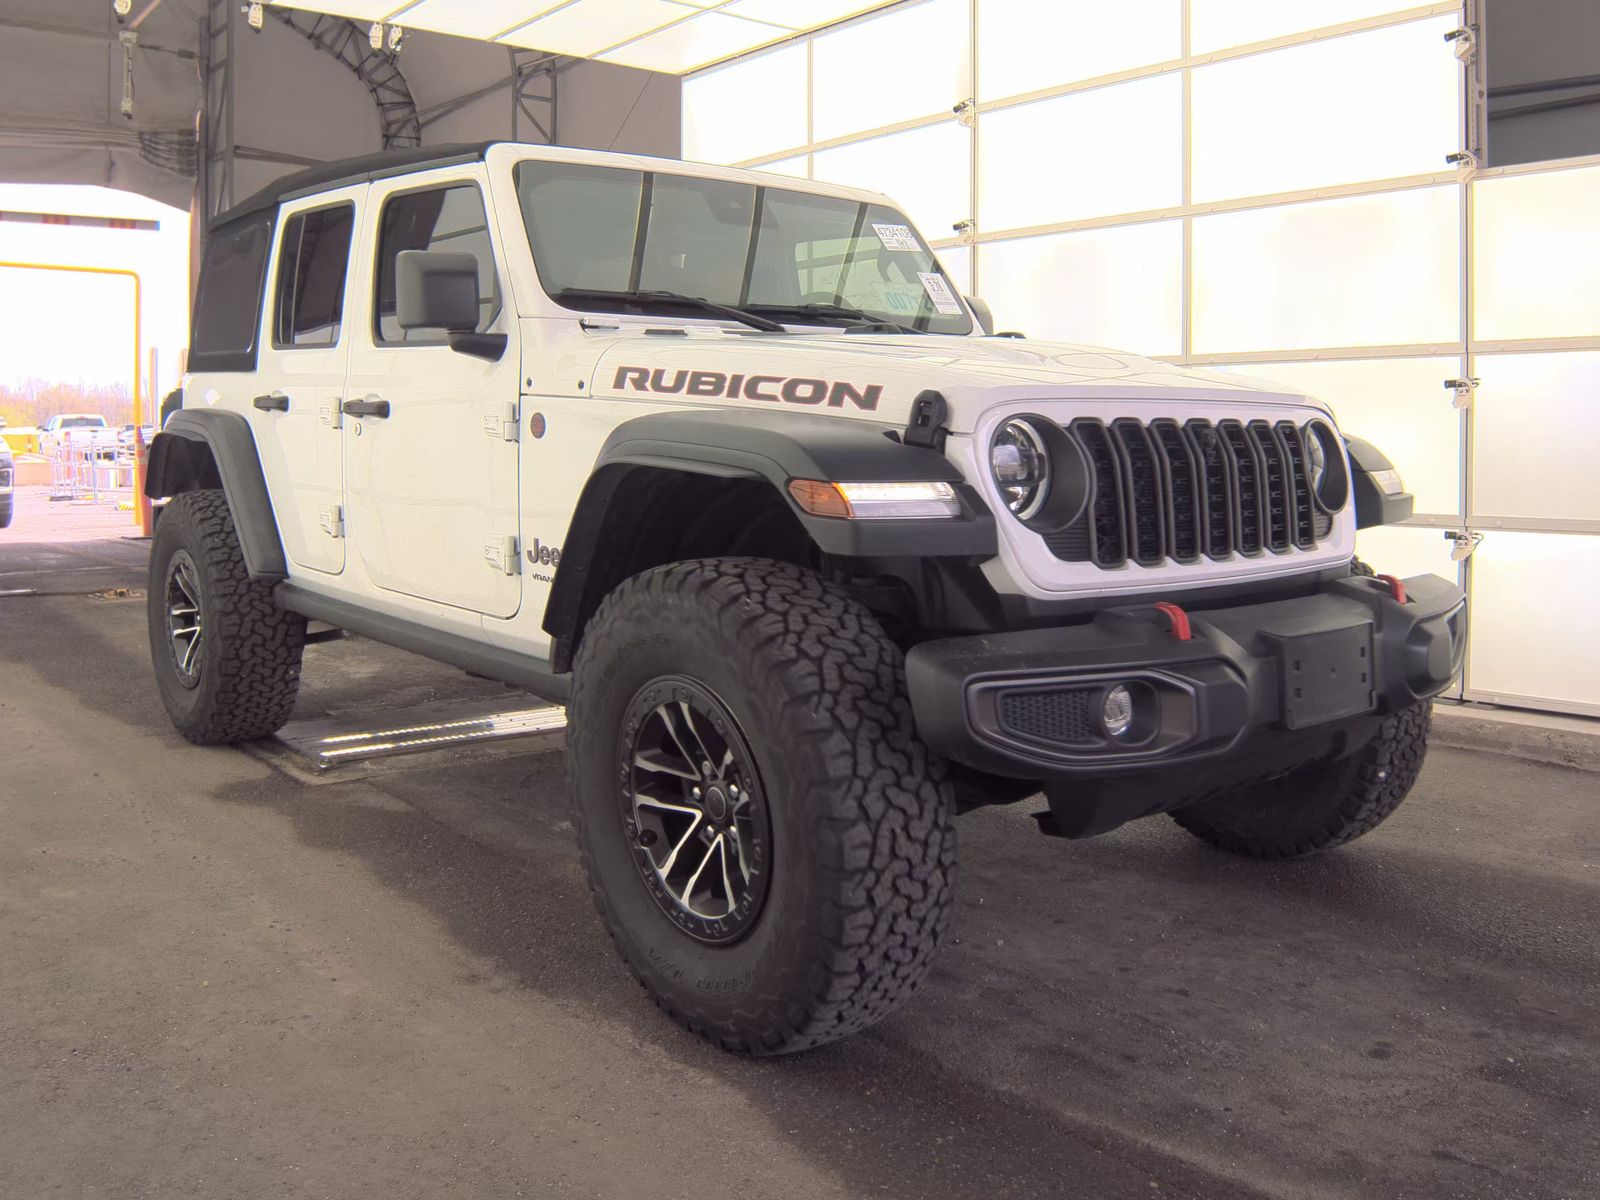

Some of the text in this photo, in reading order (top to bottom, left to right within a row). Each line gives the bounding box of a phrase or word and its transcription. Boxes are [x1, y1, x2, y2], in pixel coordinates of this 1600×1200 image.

[612, 366, 884, 411] RUBICON
[527, 538, 561, 568] Jee
[533, 573, 555, 583] WRAN
